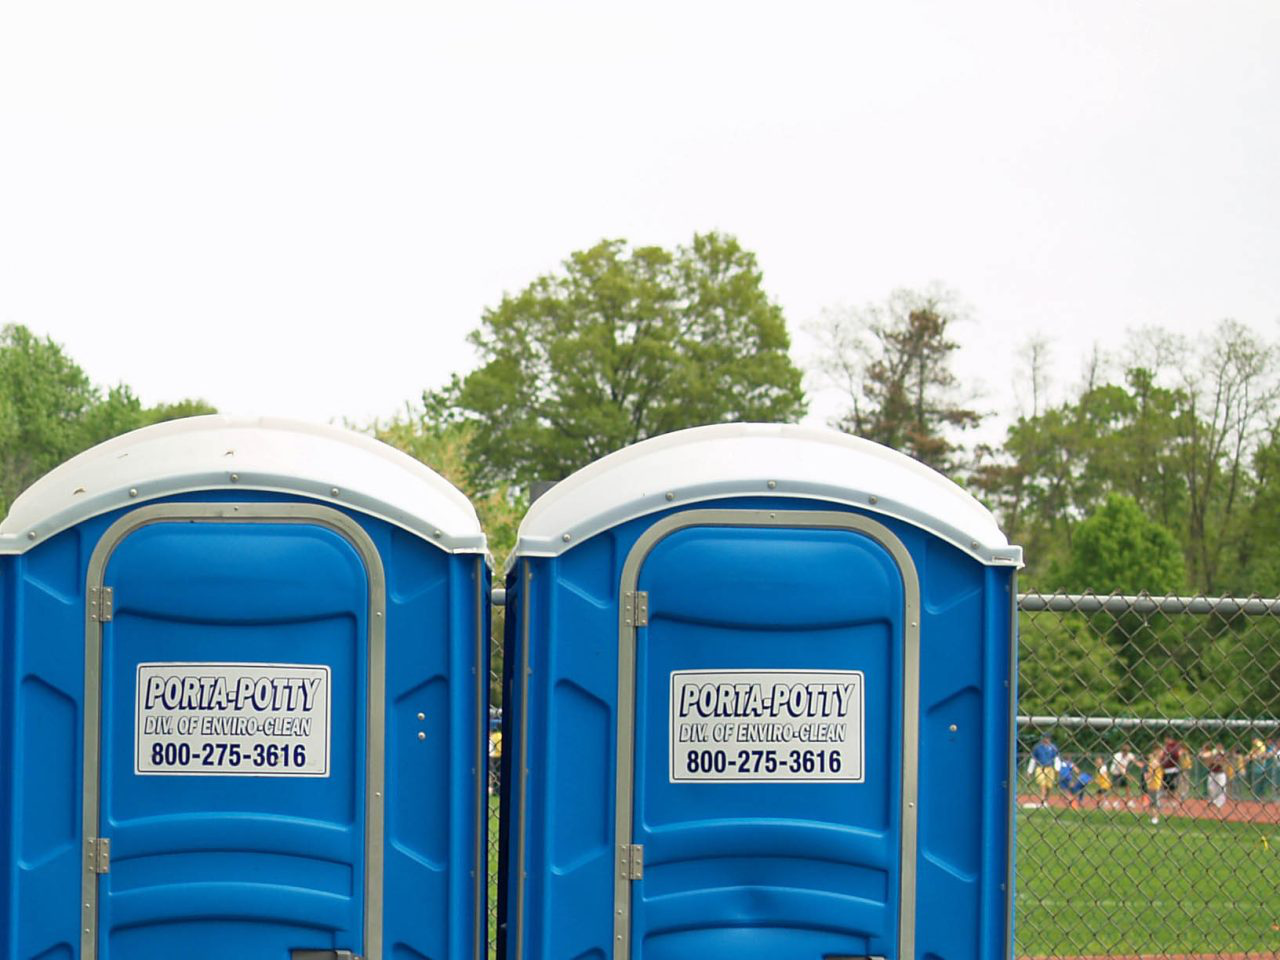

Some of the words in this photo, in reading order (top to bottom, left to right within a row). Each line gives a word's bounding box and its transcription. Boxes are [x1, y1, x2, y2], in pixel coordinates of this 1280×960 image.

[144, 676, 322, 711] PORTA-POTTY
[679, 683, 855, 717] PORTA-POTTY
[144, 716, 173, 734] DIV.
[177, 716, 199, 735] OF
[201, 716, 312, 736] ENVIRO-CLEAN
[679, 723, 709, 742] DIV.
[713, 723, 735, 742] OF
[736, 723, 847, 742] ENVIRO-CLEAN
[151, 742, 306, 767] 800-275-3616
[687, 750, 841, 773] 800-275-3616
